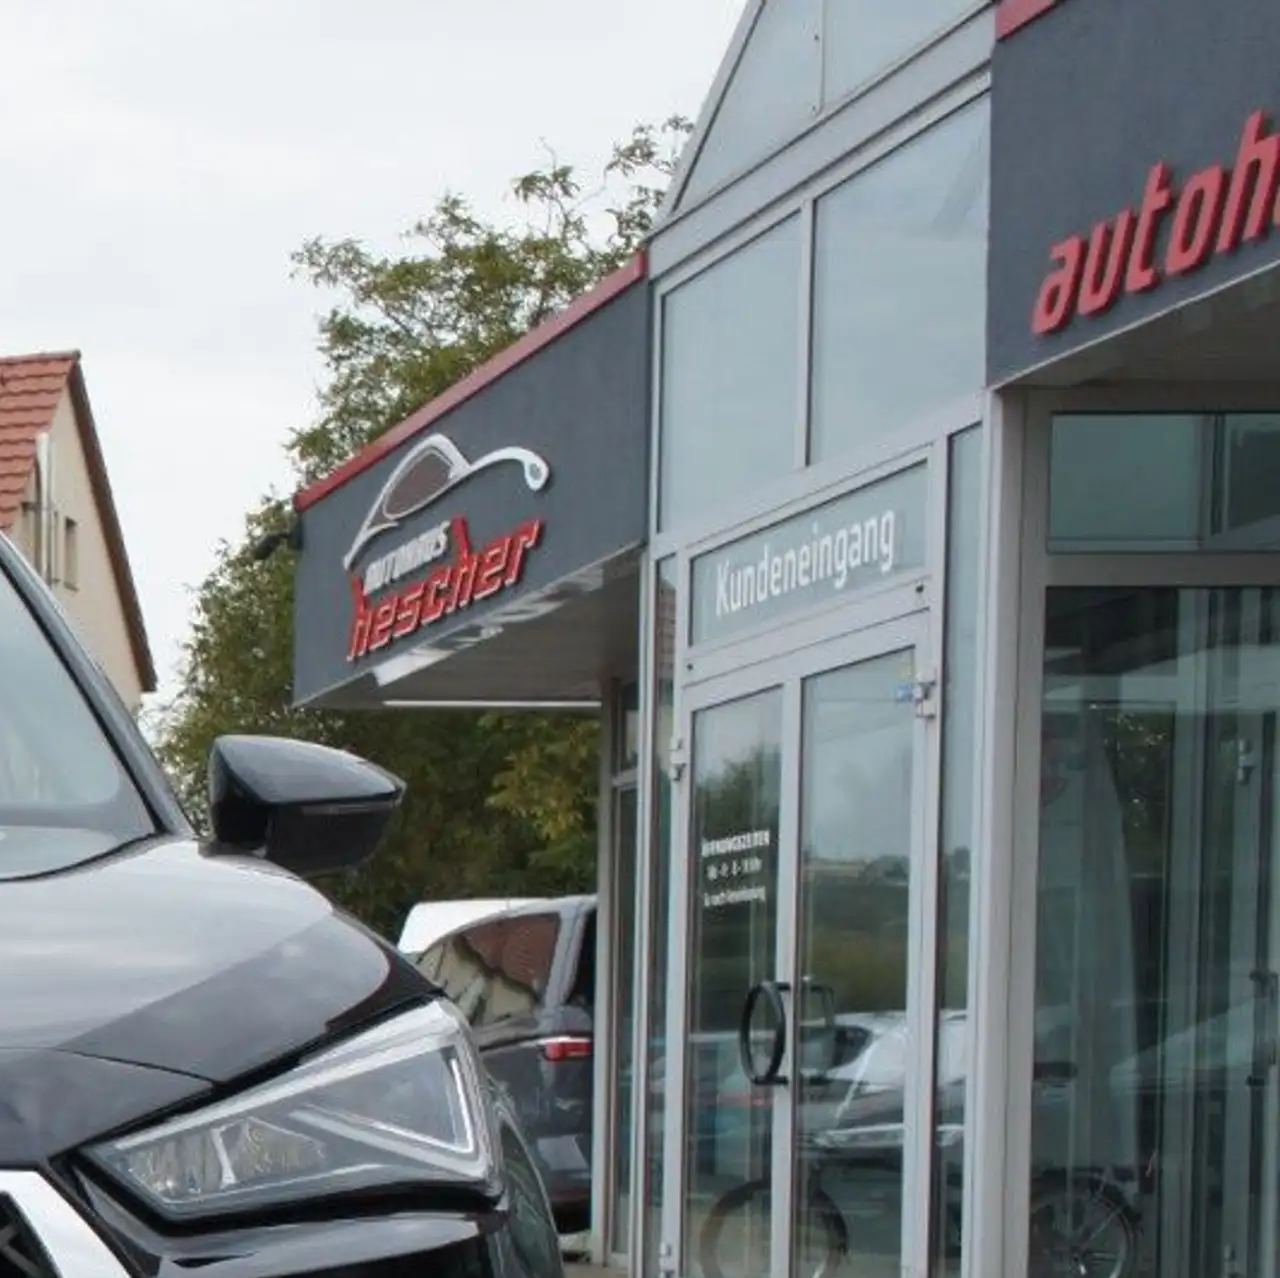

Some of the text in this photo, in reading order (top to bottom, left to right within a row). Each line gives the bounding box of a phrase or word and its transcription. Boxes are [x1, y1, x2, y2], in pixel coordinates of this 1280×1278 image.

[1032, 108, 1280, 334] autoh
[346, 514, 542, 662] hescher
[716, 510, 895, 617] Kundeneingang
